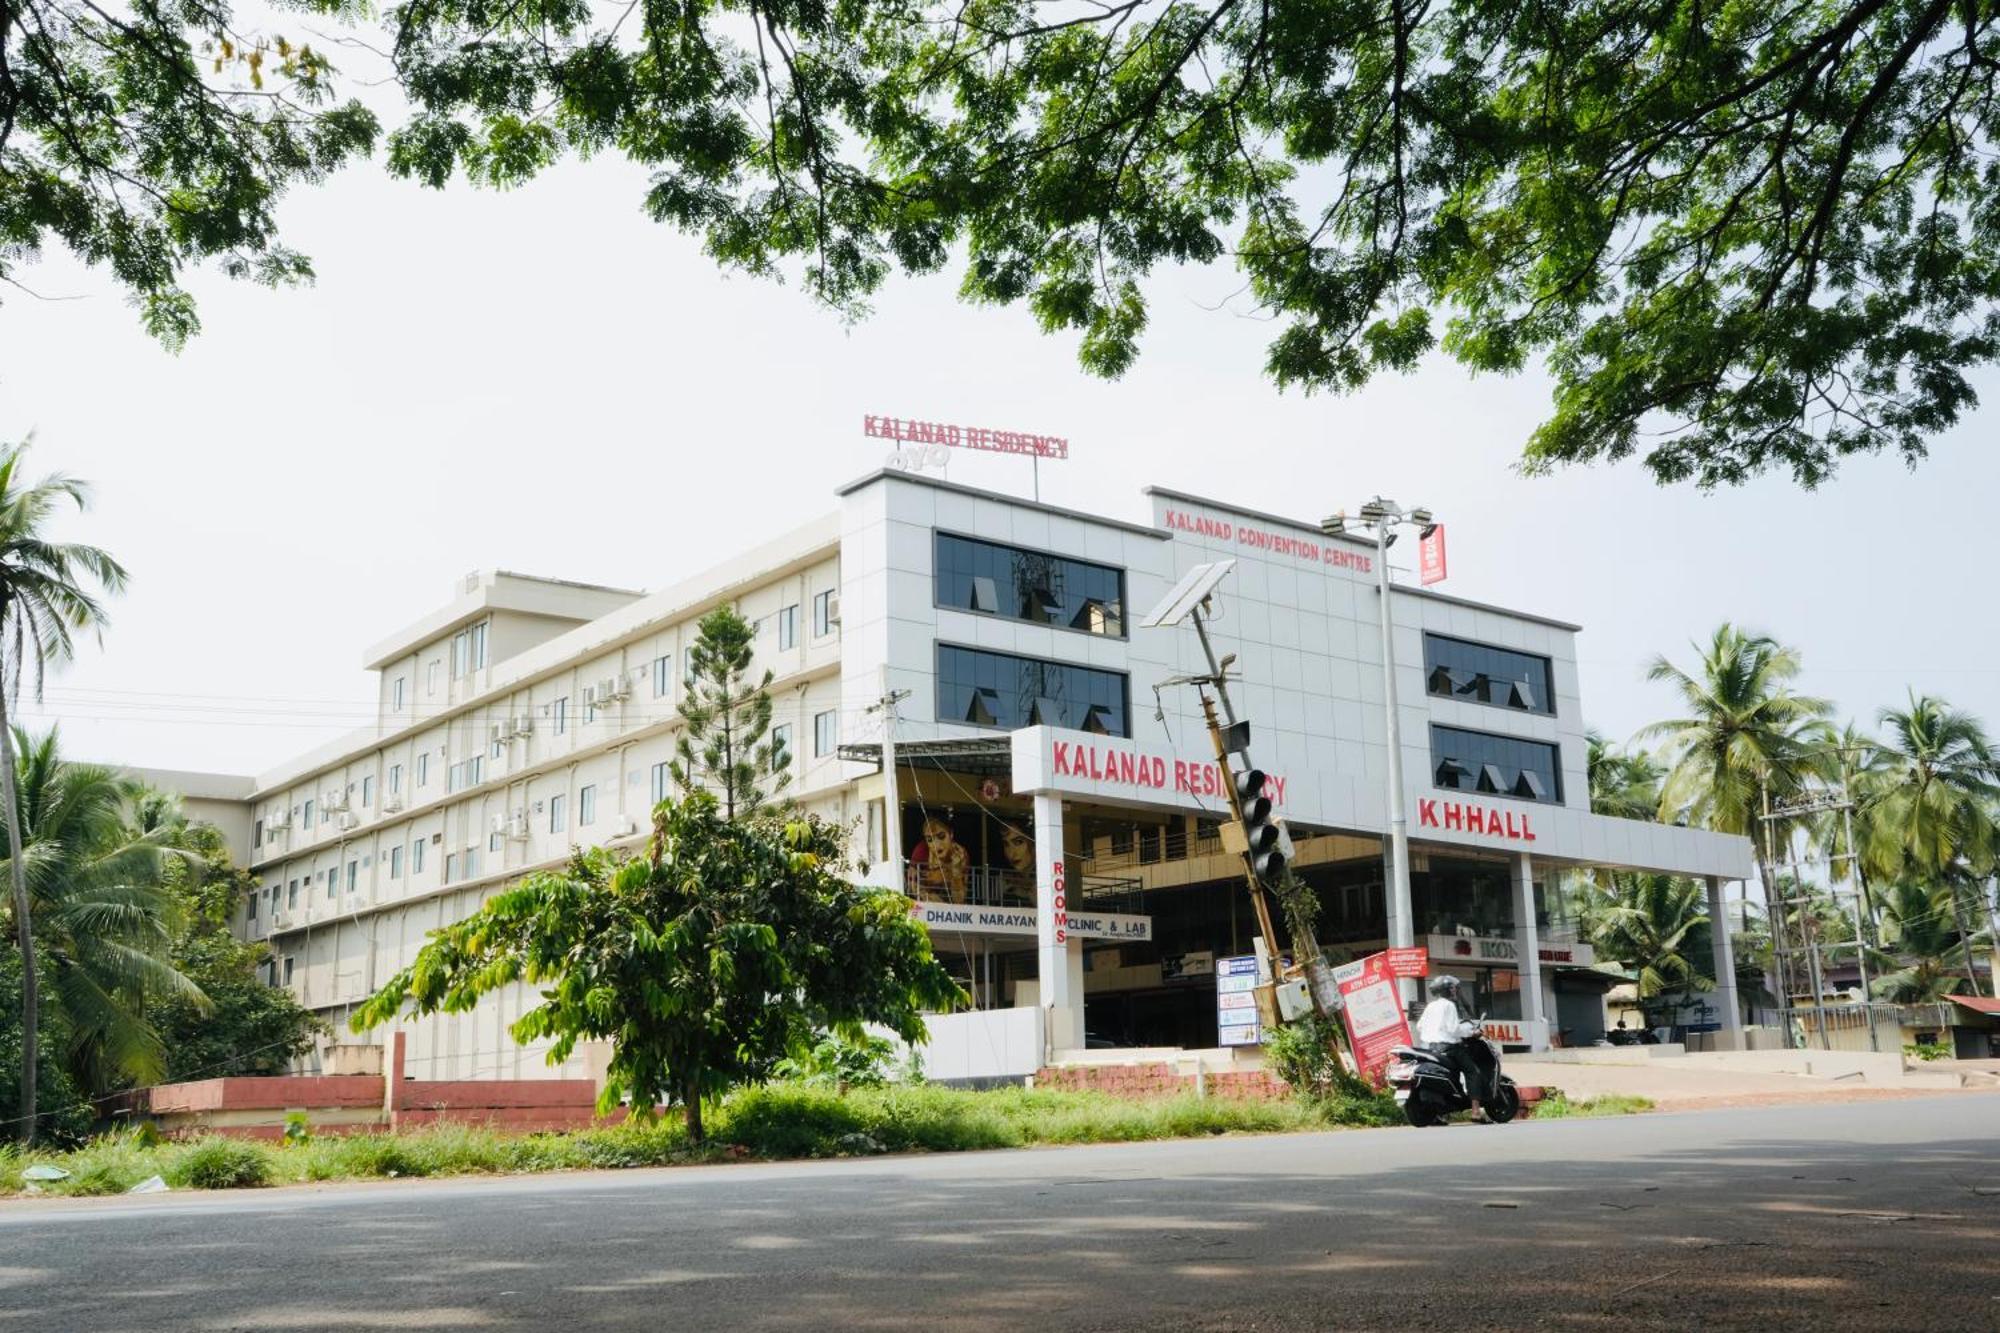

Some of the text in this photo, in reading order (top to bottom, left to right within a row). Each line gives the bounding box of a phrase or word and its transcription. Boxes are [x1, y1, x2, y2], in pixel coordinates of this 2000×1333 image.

[864, 415, 1069, 460] KALANAD RESIDENCY
[1166, 510, 1372, 573] KALANAD CONVENTION CENTRE
[1053, 740, 1287, 805] KALANAD RESICY
[926, 910, 1037, 928] DHANIK NARAYAN
[1054, 862, 1068, 943] ROOMS
[1067, 918, 1146, 934] CLINIC & LAB
